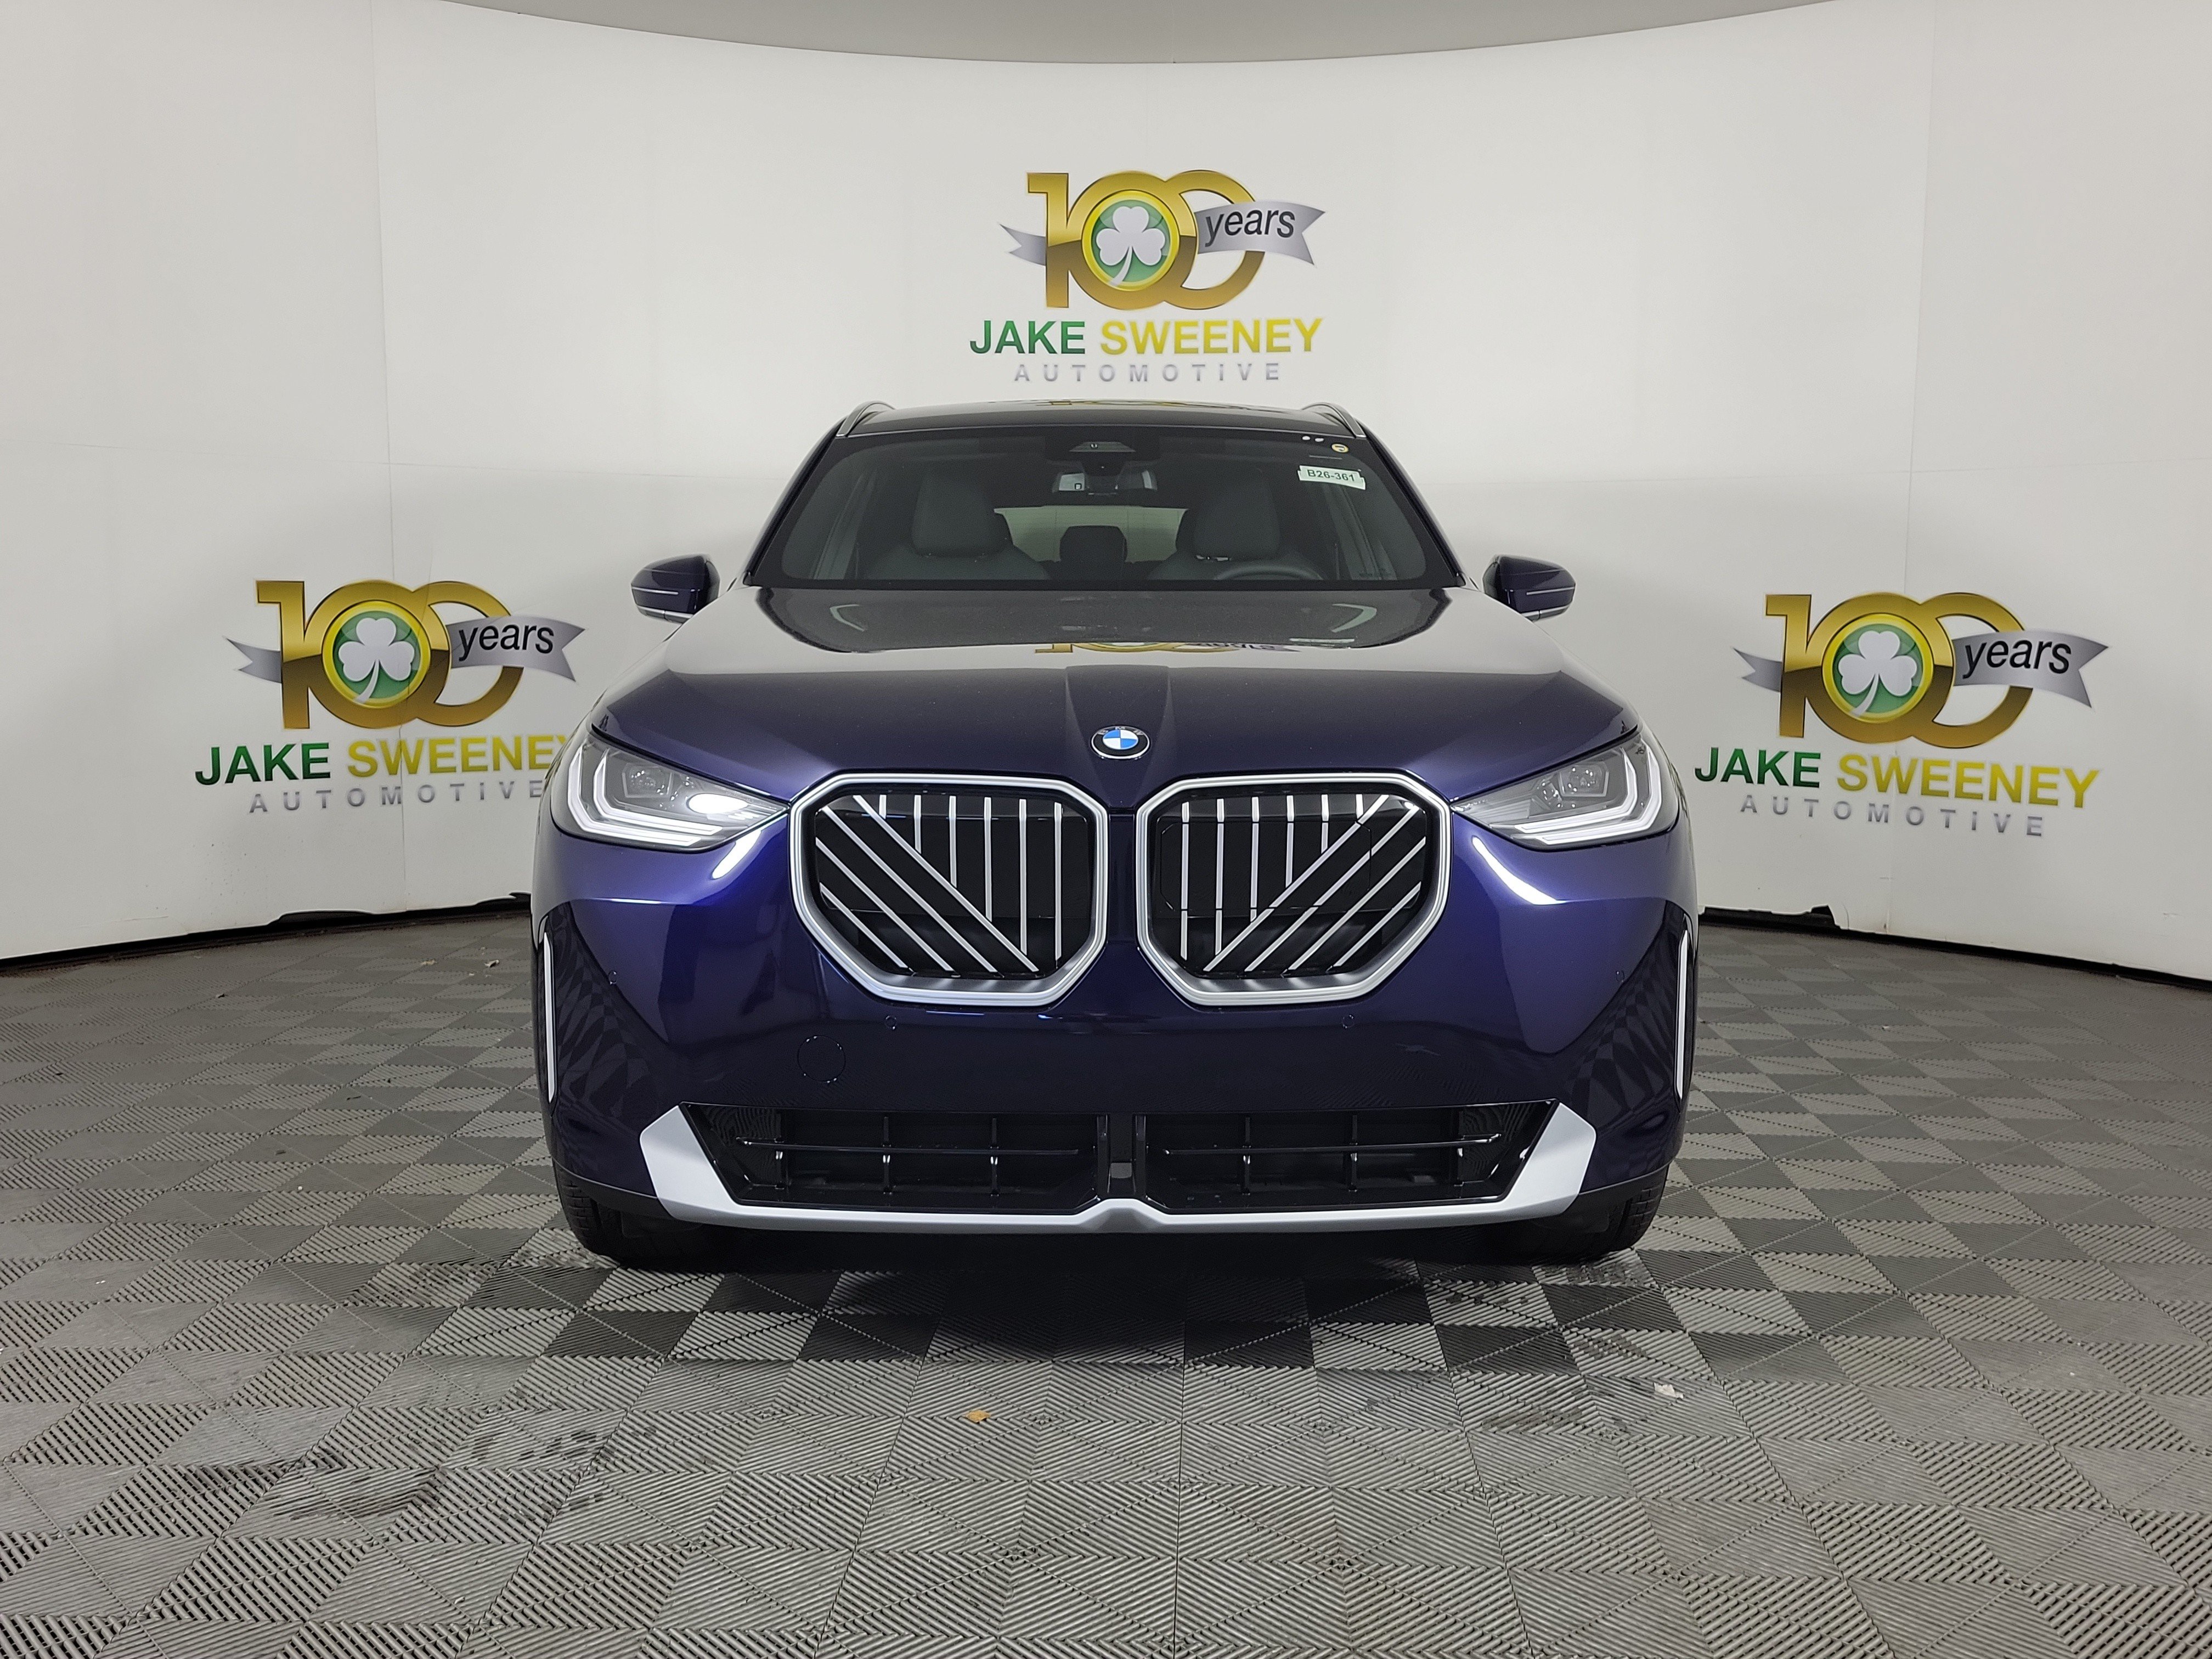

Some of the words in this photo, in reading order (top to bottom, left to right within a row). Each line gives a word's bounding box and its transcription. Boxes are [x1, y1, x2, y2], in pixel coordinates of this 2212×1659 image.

[1027, 170, 1265, 310] 100
[1205, 209, 1295, 246] years
[969, 320, 1085, 354] JAKE
[1100, 318, 1323, 355] SWEENEY
[1014, 363, 1279, 382] AUTOMOTIVE
[1307, 469, 1355, 482] B26-361
[255, 579, 524, 729] 100
[459, 624, 555, 661] years
[1765, 592, 2033, 749] 100
[1962, 637, 2072, 680] years
[195, 742, 330, 785] JAKE
[347, 734, 566, 777] SWEENE
[1695, 747, 1821, 788] JAKE
[1836, 753, 2100, 809] SWEENEY
[249, 780, 543, 814] AUTOMOTIVE
[1740, 794, 2044, 837] AUTOMOTIVE
